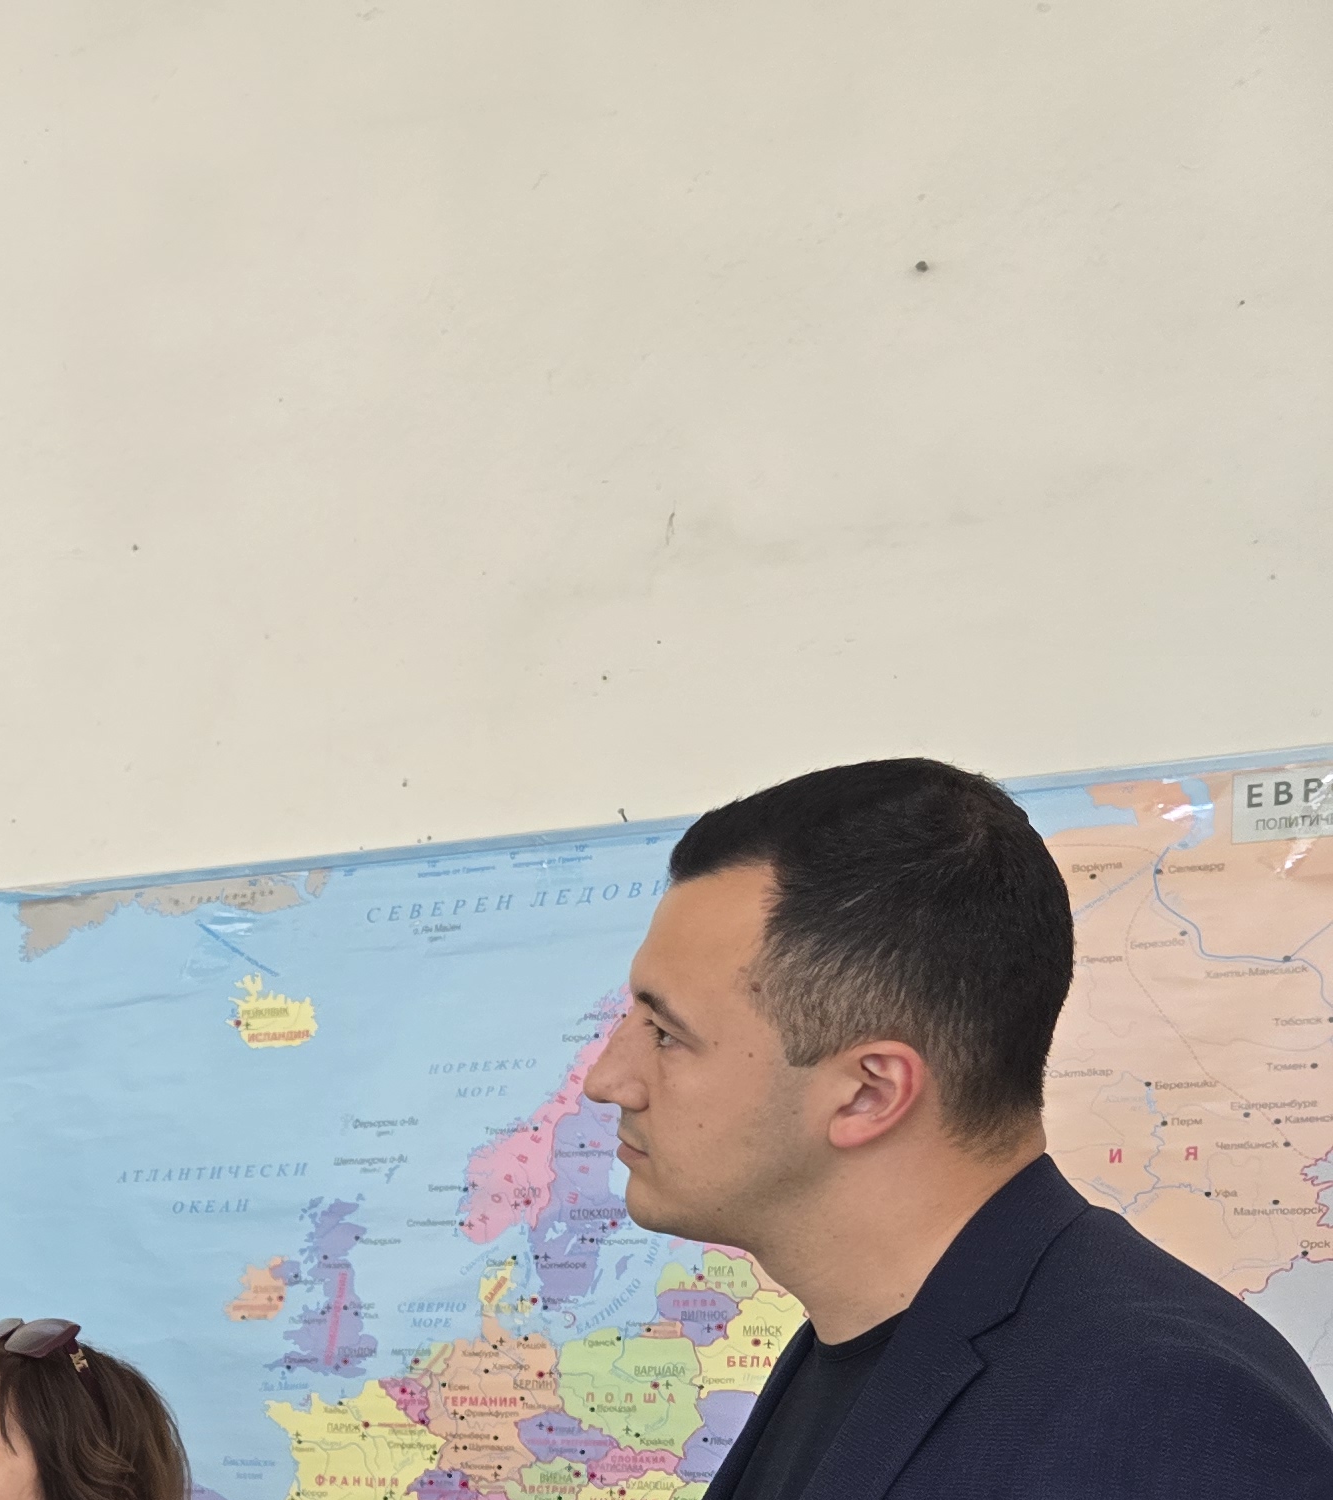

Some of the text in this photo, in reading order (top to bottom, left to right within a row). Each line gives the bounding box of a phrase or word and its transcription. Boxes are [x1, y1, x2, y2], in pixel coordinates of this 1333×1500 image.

[1246, 777, 1333, 809] ЕВР
[366, 894, 513, 924] СЕВЕРЕН
[247, 1030, 311, 1043] ИСЛАНДИЯ
[428, 1058, 538, 1075] НОРВЕЖКО
[1266, 1061, 1307, 1073] Тюмен
[1154, 1079, 1218, 1092] Березники
[455, 1085, 509, 1099] МОРЕ
[1171, 1117, 1203, 1127] Перм
[116, 1162, 308, 1184] АТЛАНТИЧЕСКИ
[513, 1186, 541, 1199] ОСЛО
[1214, 1189, 1238, 1200] Уфа
[171, 1198, 250, 1215] ОКЕАН
[1233, 1206, 1324, 1217] Магнитогорск
[569, 1206, 627, 1220] СТОКХОЛМ
[1300, 1240, 1331, 1251] Орск
[707, 1265, 734, 1277] РИГА
[678, 1280, 749, 1290] ЛАТВИЯ
[397, 1302, 467, 1313] СЕВЕРНО
[576, 1277, 642, 1333] БАЛТИЙСКО
[672, 1298, 717, 1308] ЛИТВА
[680, 1310, 728, 1321] ВИЛНЮС
[410, 1318, 452, 1329] МОРЕ
[742, 1325, 783, 1337] МИНСК
[726, 1356, 779, 1369] БЕЛА
[634, 1365, 686, 1377] ВАРШАВА
[513, 1380, 553, 1390] БЕРЛИН
[702, 1376, 735, 1386] Брест
[444, 1396, 517, 1407] ГЕРМАНИЯ
[585, 1392, 676, 1404] ПОЛША
[327, 1423, 361, 1434] ПАРИЖ
[610, 1455, 667, 1464] СЛОВАКИЯ
[315, 1474, 399, 1488] ФРАНЦИЯ
[539, 1473, 573, 1483] ВИЕНА
[521, 1485, 577, 1494] АВСТРИЯ
